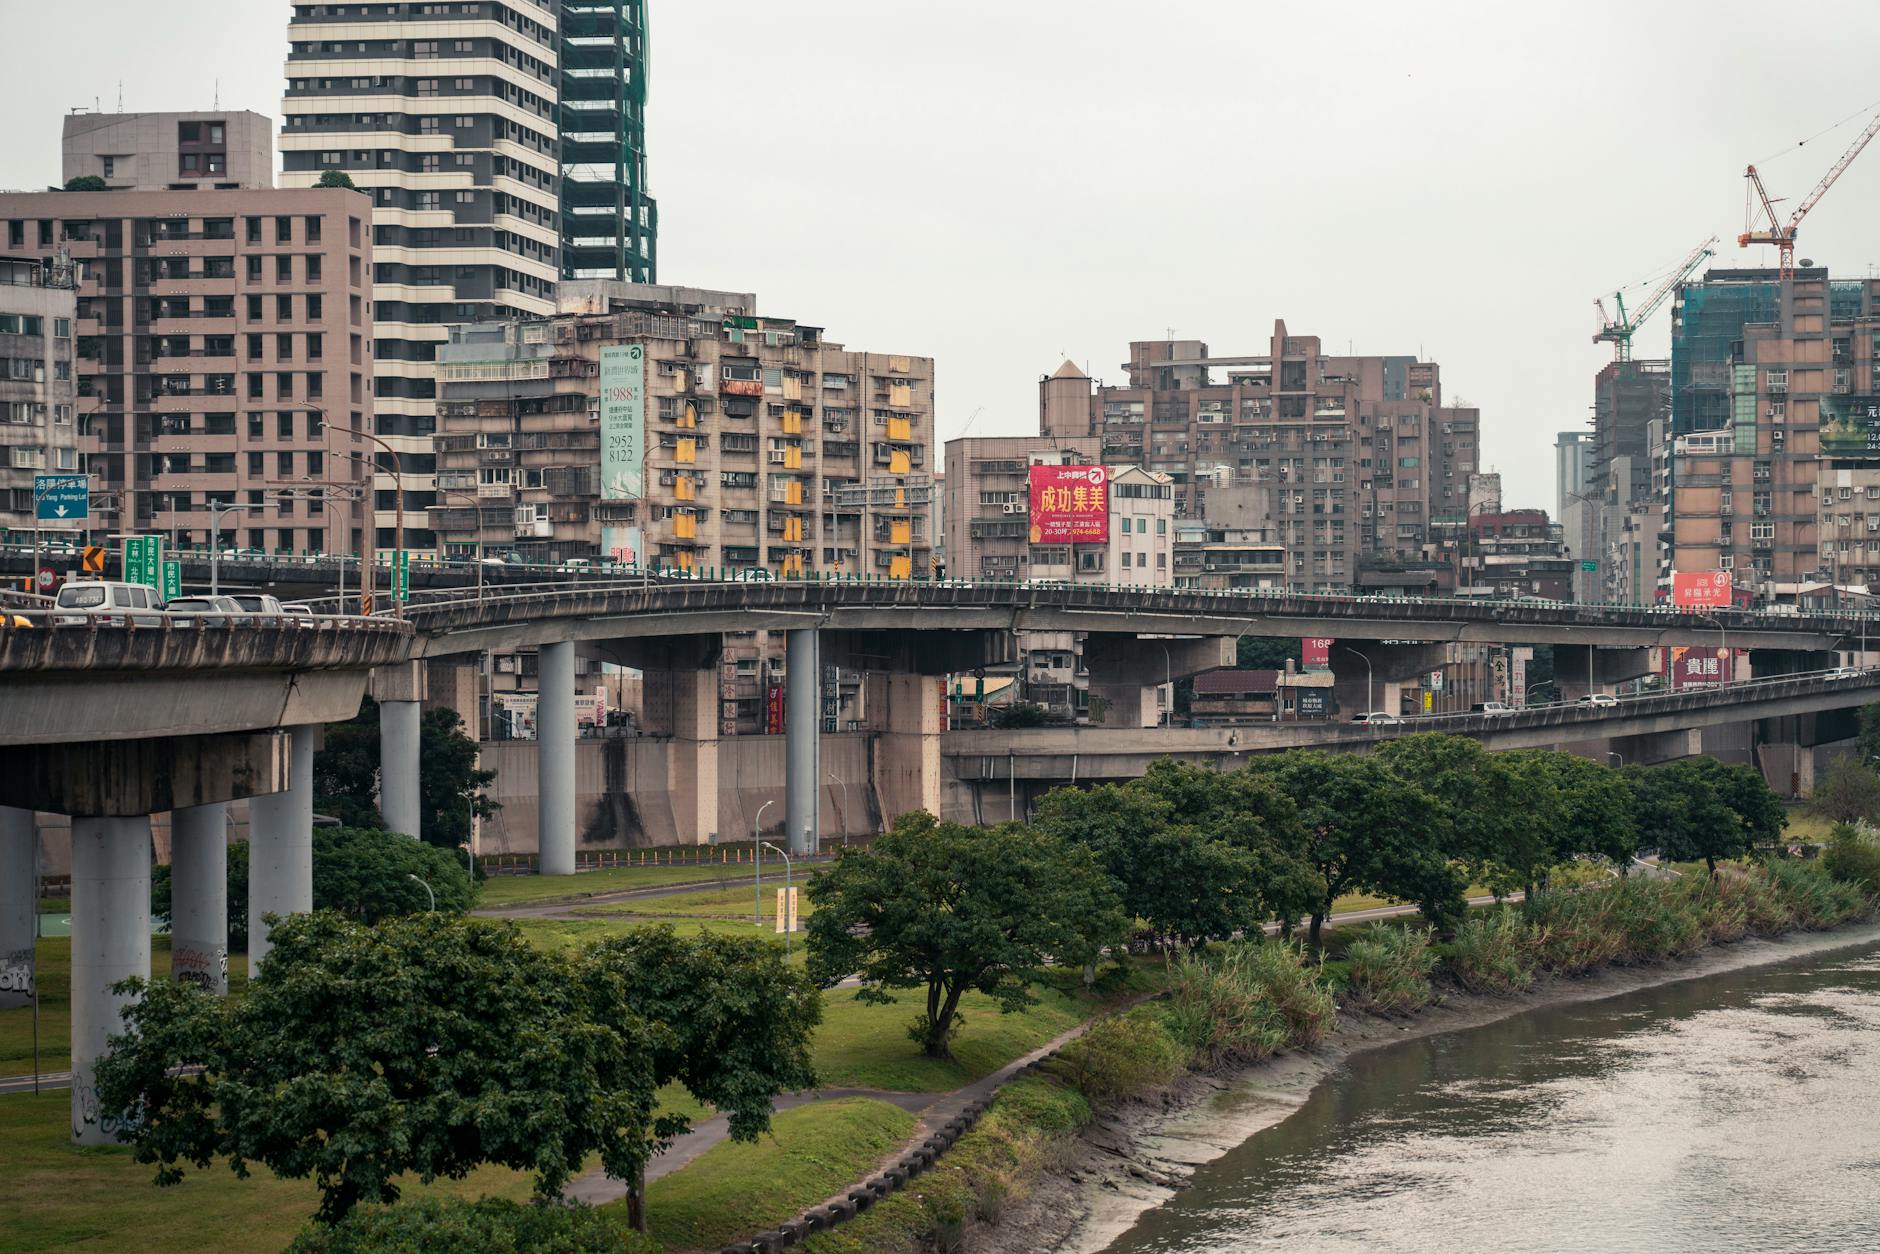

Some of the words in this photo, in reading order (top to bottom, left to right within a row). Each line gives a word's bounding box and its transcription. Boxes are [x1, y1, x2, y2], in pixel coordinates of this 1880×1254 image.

[609, 386, 633, 402] 1988
[609, 435, 633, 448] 2952
[609, 449, 633, 463] 8122
[1041, 486, 1104, 512] 成功集美
[131, 541, 139, 558] 士林
[147, 538, 155, 575] 市民大道
[167, 562, 177, 595] 市民大道
